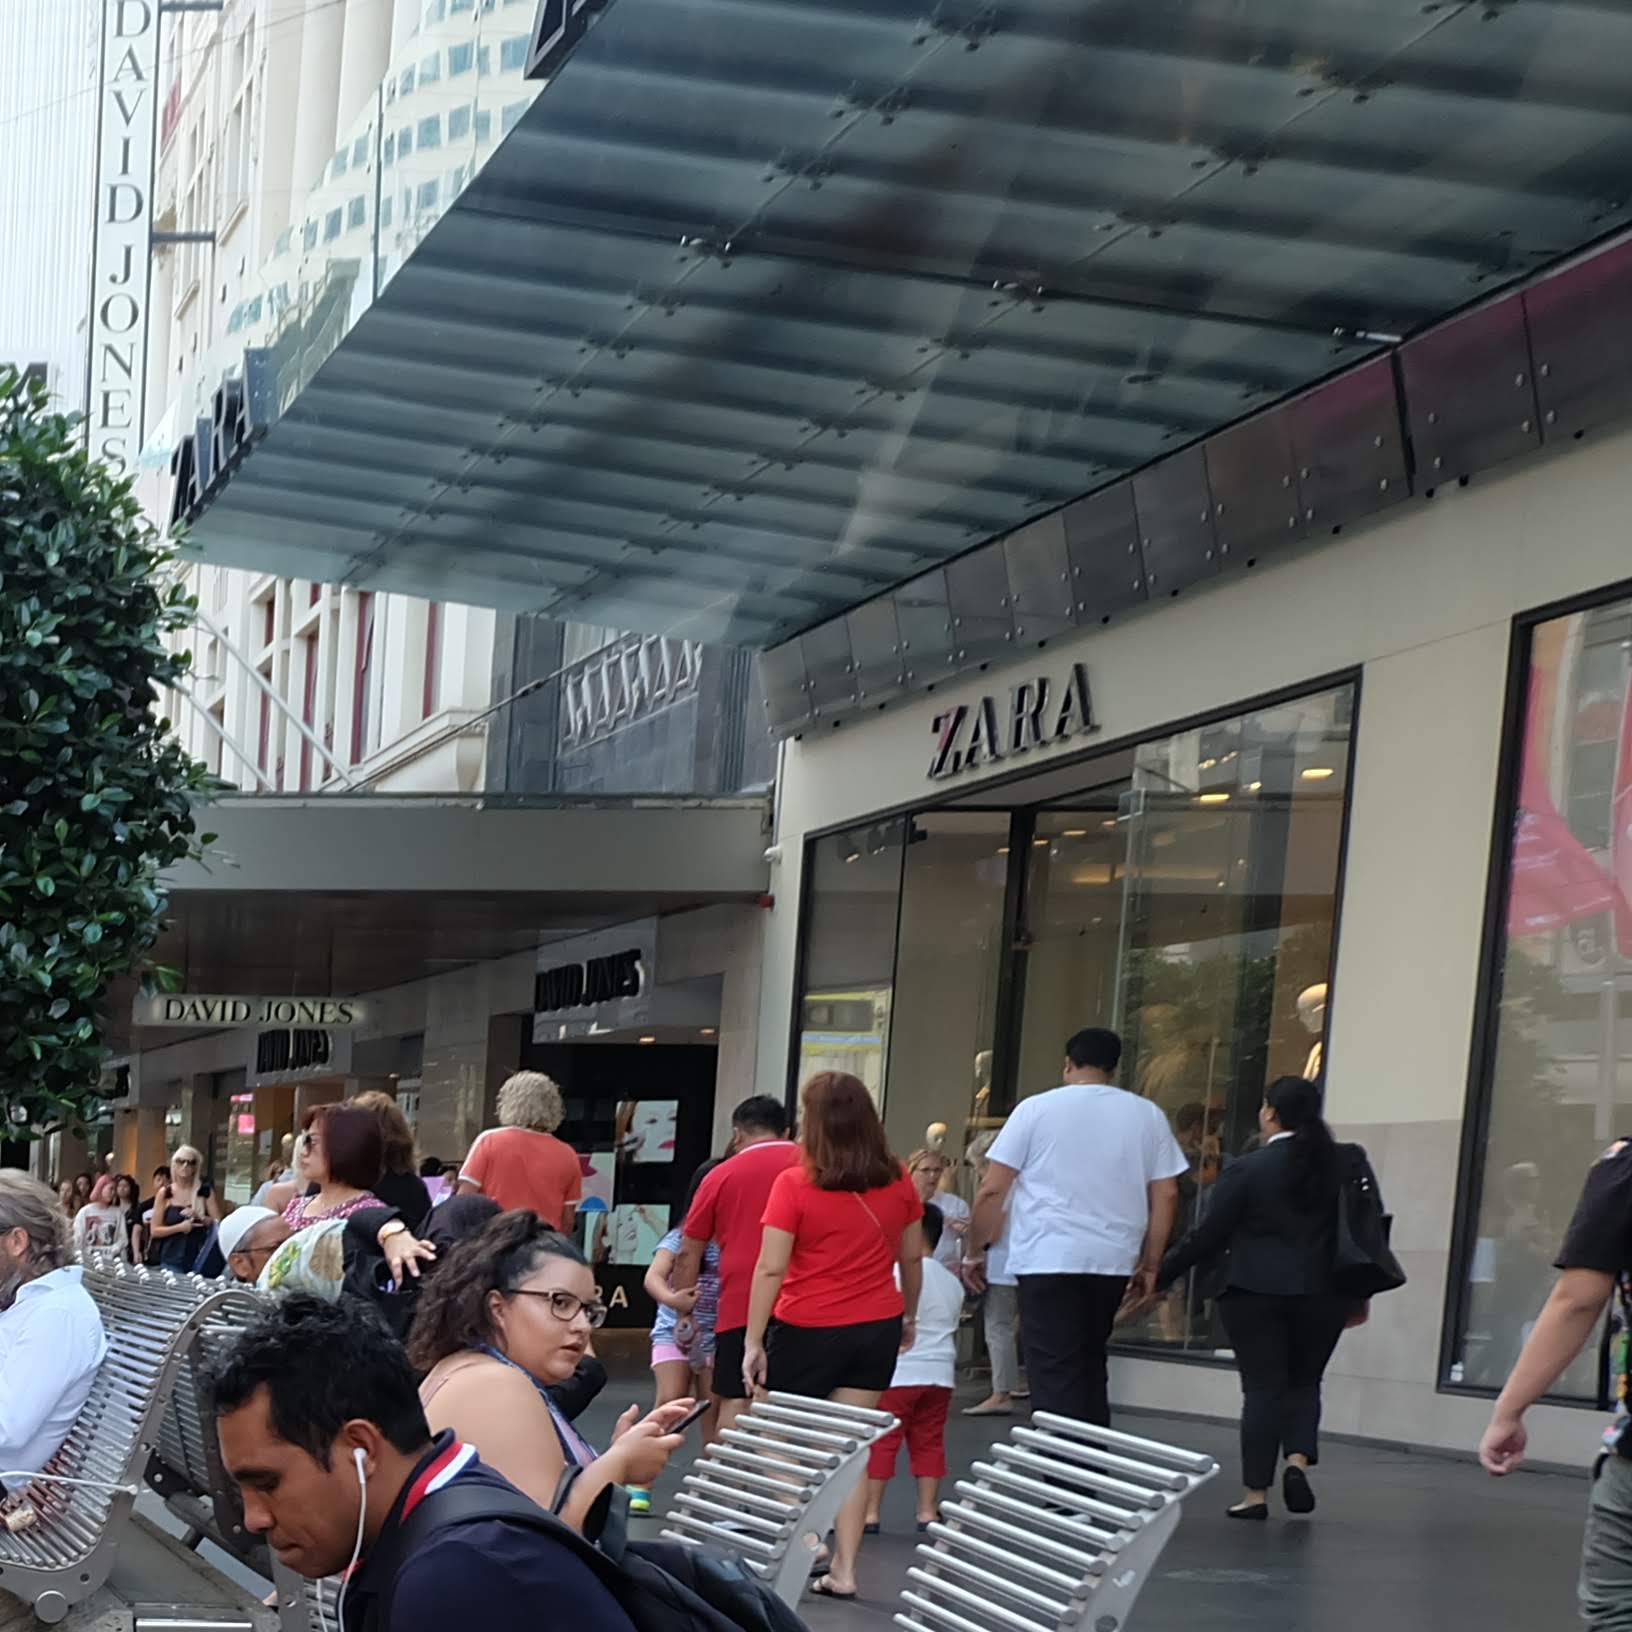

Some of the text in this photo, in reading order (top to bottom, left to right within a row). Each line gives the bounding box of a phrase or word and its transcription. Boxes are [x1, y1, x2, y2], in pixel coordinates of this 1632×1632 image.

[98, 0, 152, 478] DAVID JONES
[926, 662, 1100, 781] ZARA
[164, 999, 354, 1025] DAVID JONES
